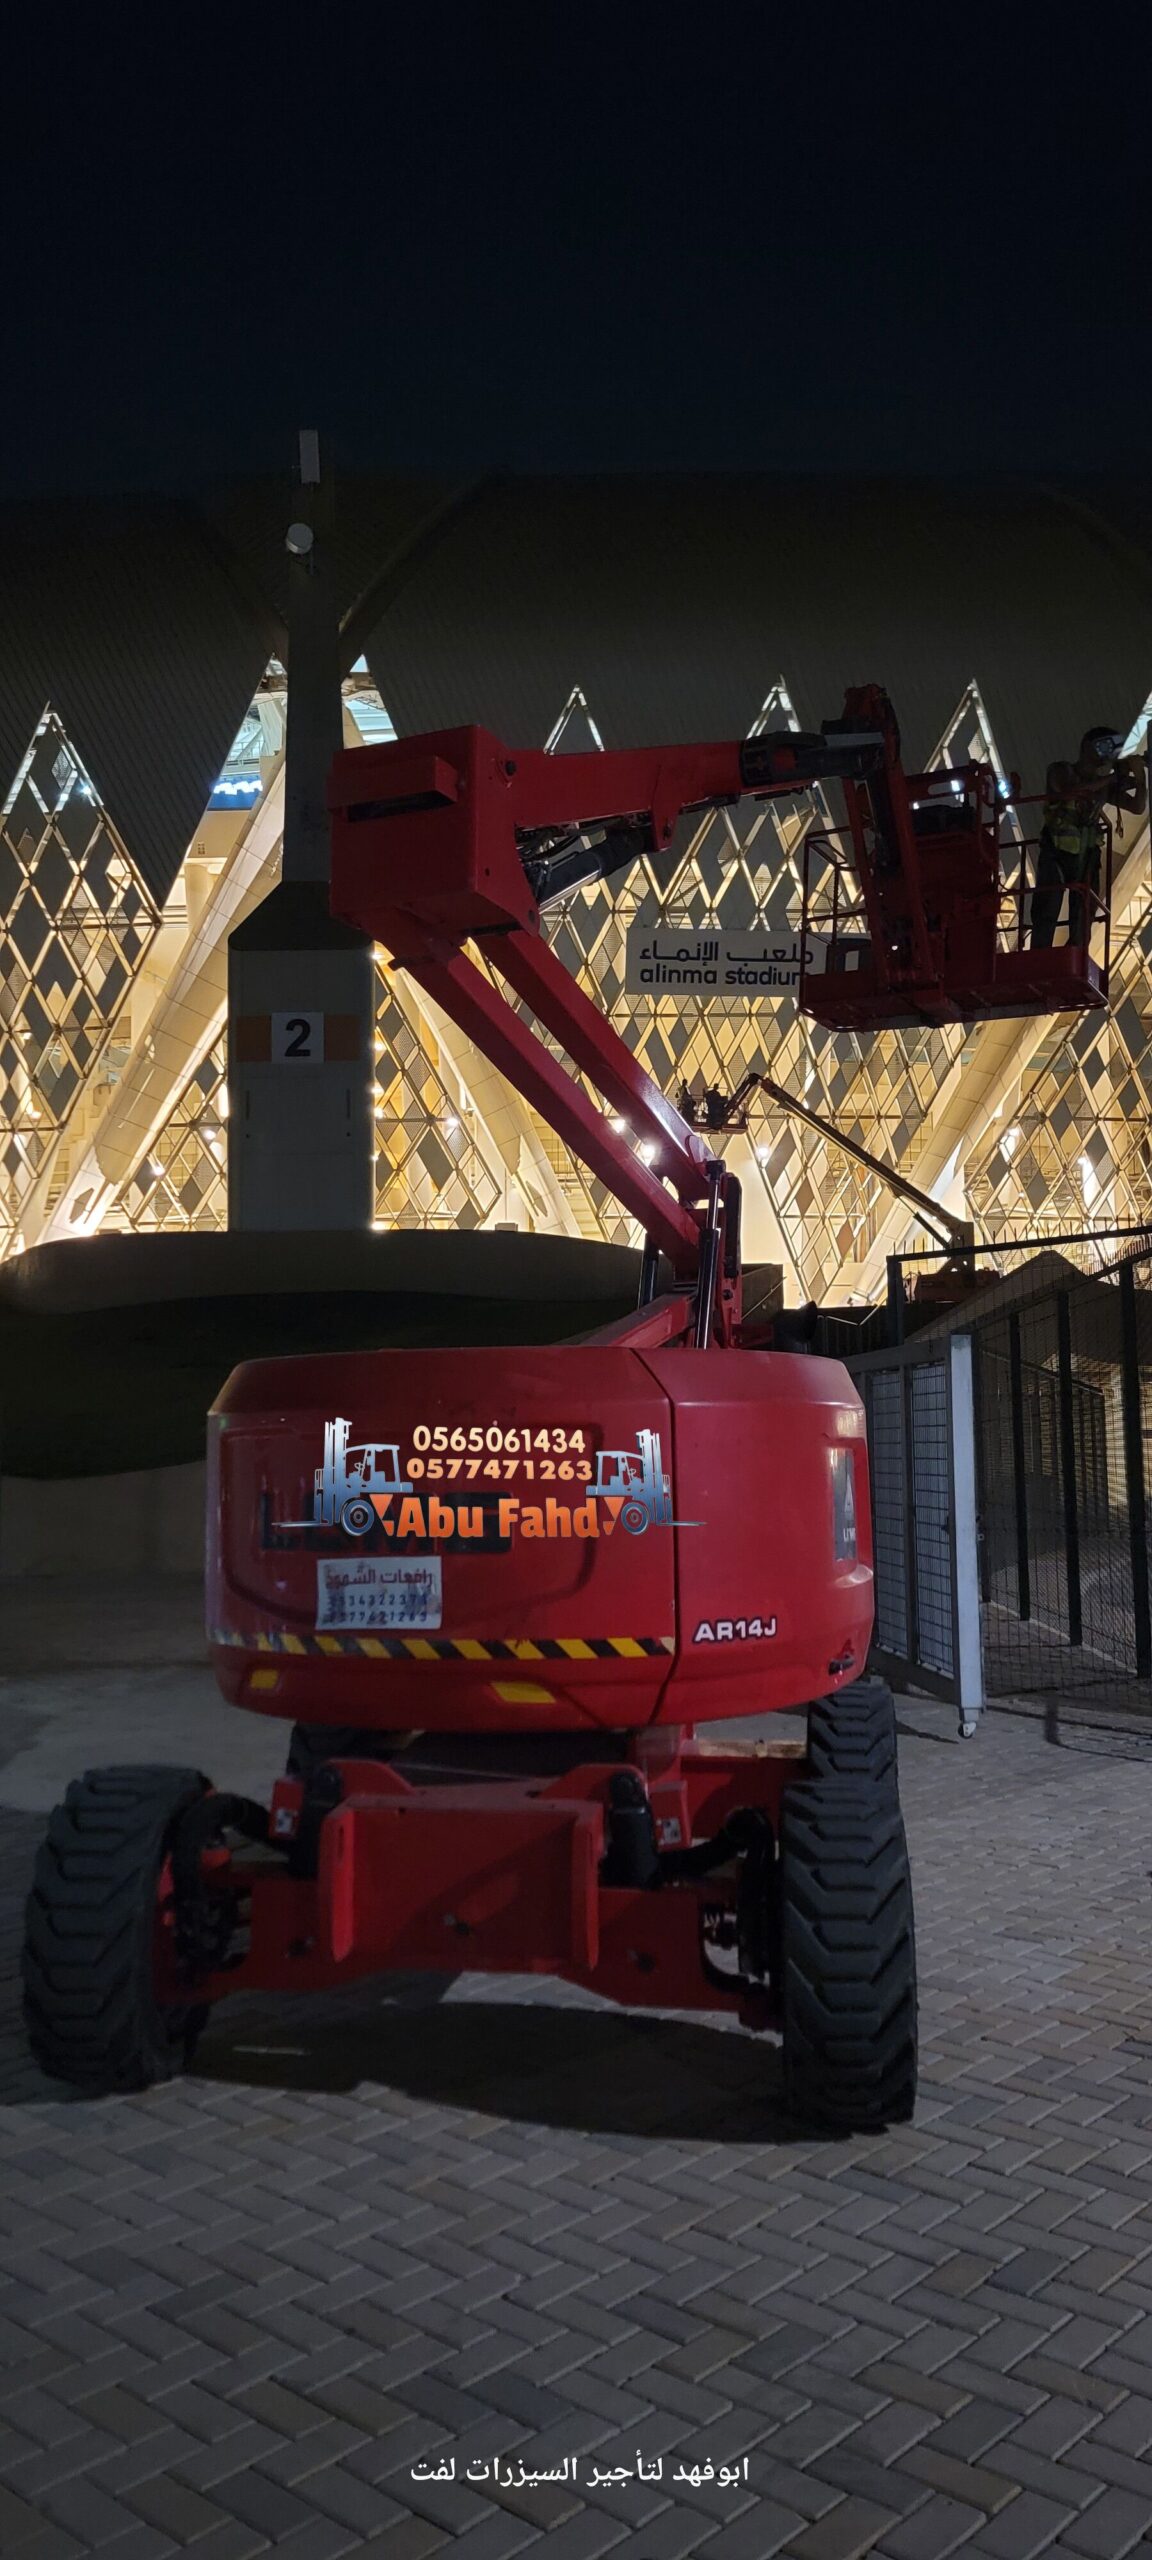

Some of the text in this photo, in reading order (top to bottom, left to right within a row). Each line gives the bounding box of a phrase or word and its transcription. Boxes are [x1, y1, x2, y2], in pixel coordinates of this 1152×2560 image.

[639, 940, 814, 968] ملعب الإنماء
[640, 963, 718, 985] alinma
[284, 1018, 311, 1057] 2
[693, 1616, 777, 1642] AR14J
